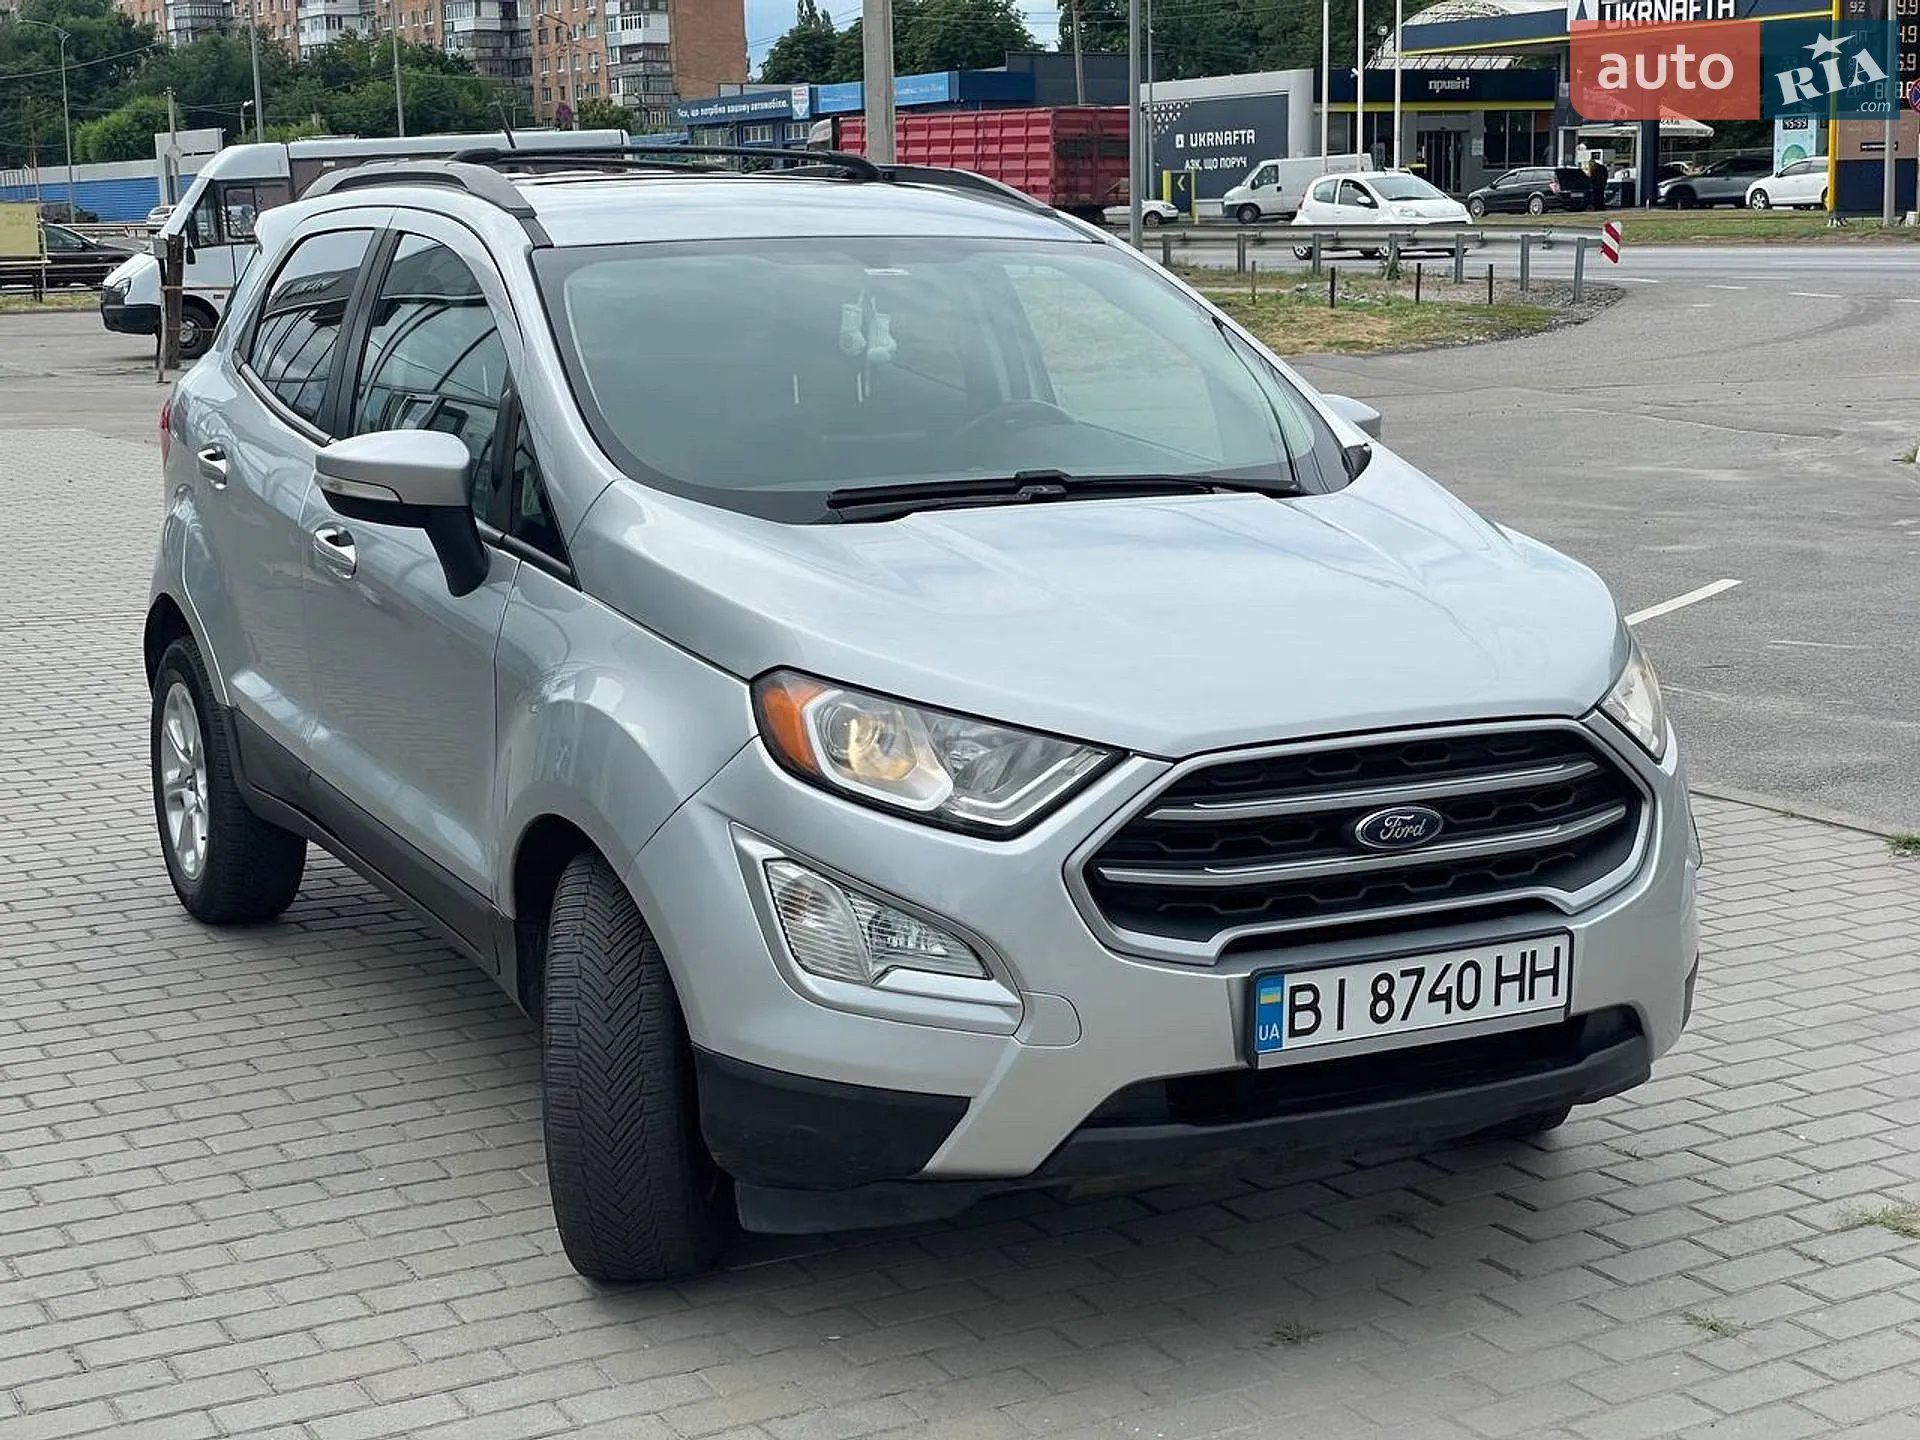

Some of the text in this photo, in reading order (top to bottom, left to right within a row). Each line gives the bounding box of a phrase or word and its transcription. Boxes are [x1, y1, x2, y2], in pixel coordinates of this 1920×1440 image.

[1849, 1, 1866, 13] 92
[1190, 129, 1255, 147] UKRNAFTA
[1379, 815, 1427, 840] Ford
[1369, 959, 1482, 1025] 8740
[1493, 946, 1561, 1007] HH
[1258, 1023, 1280, 1042] UA
